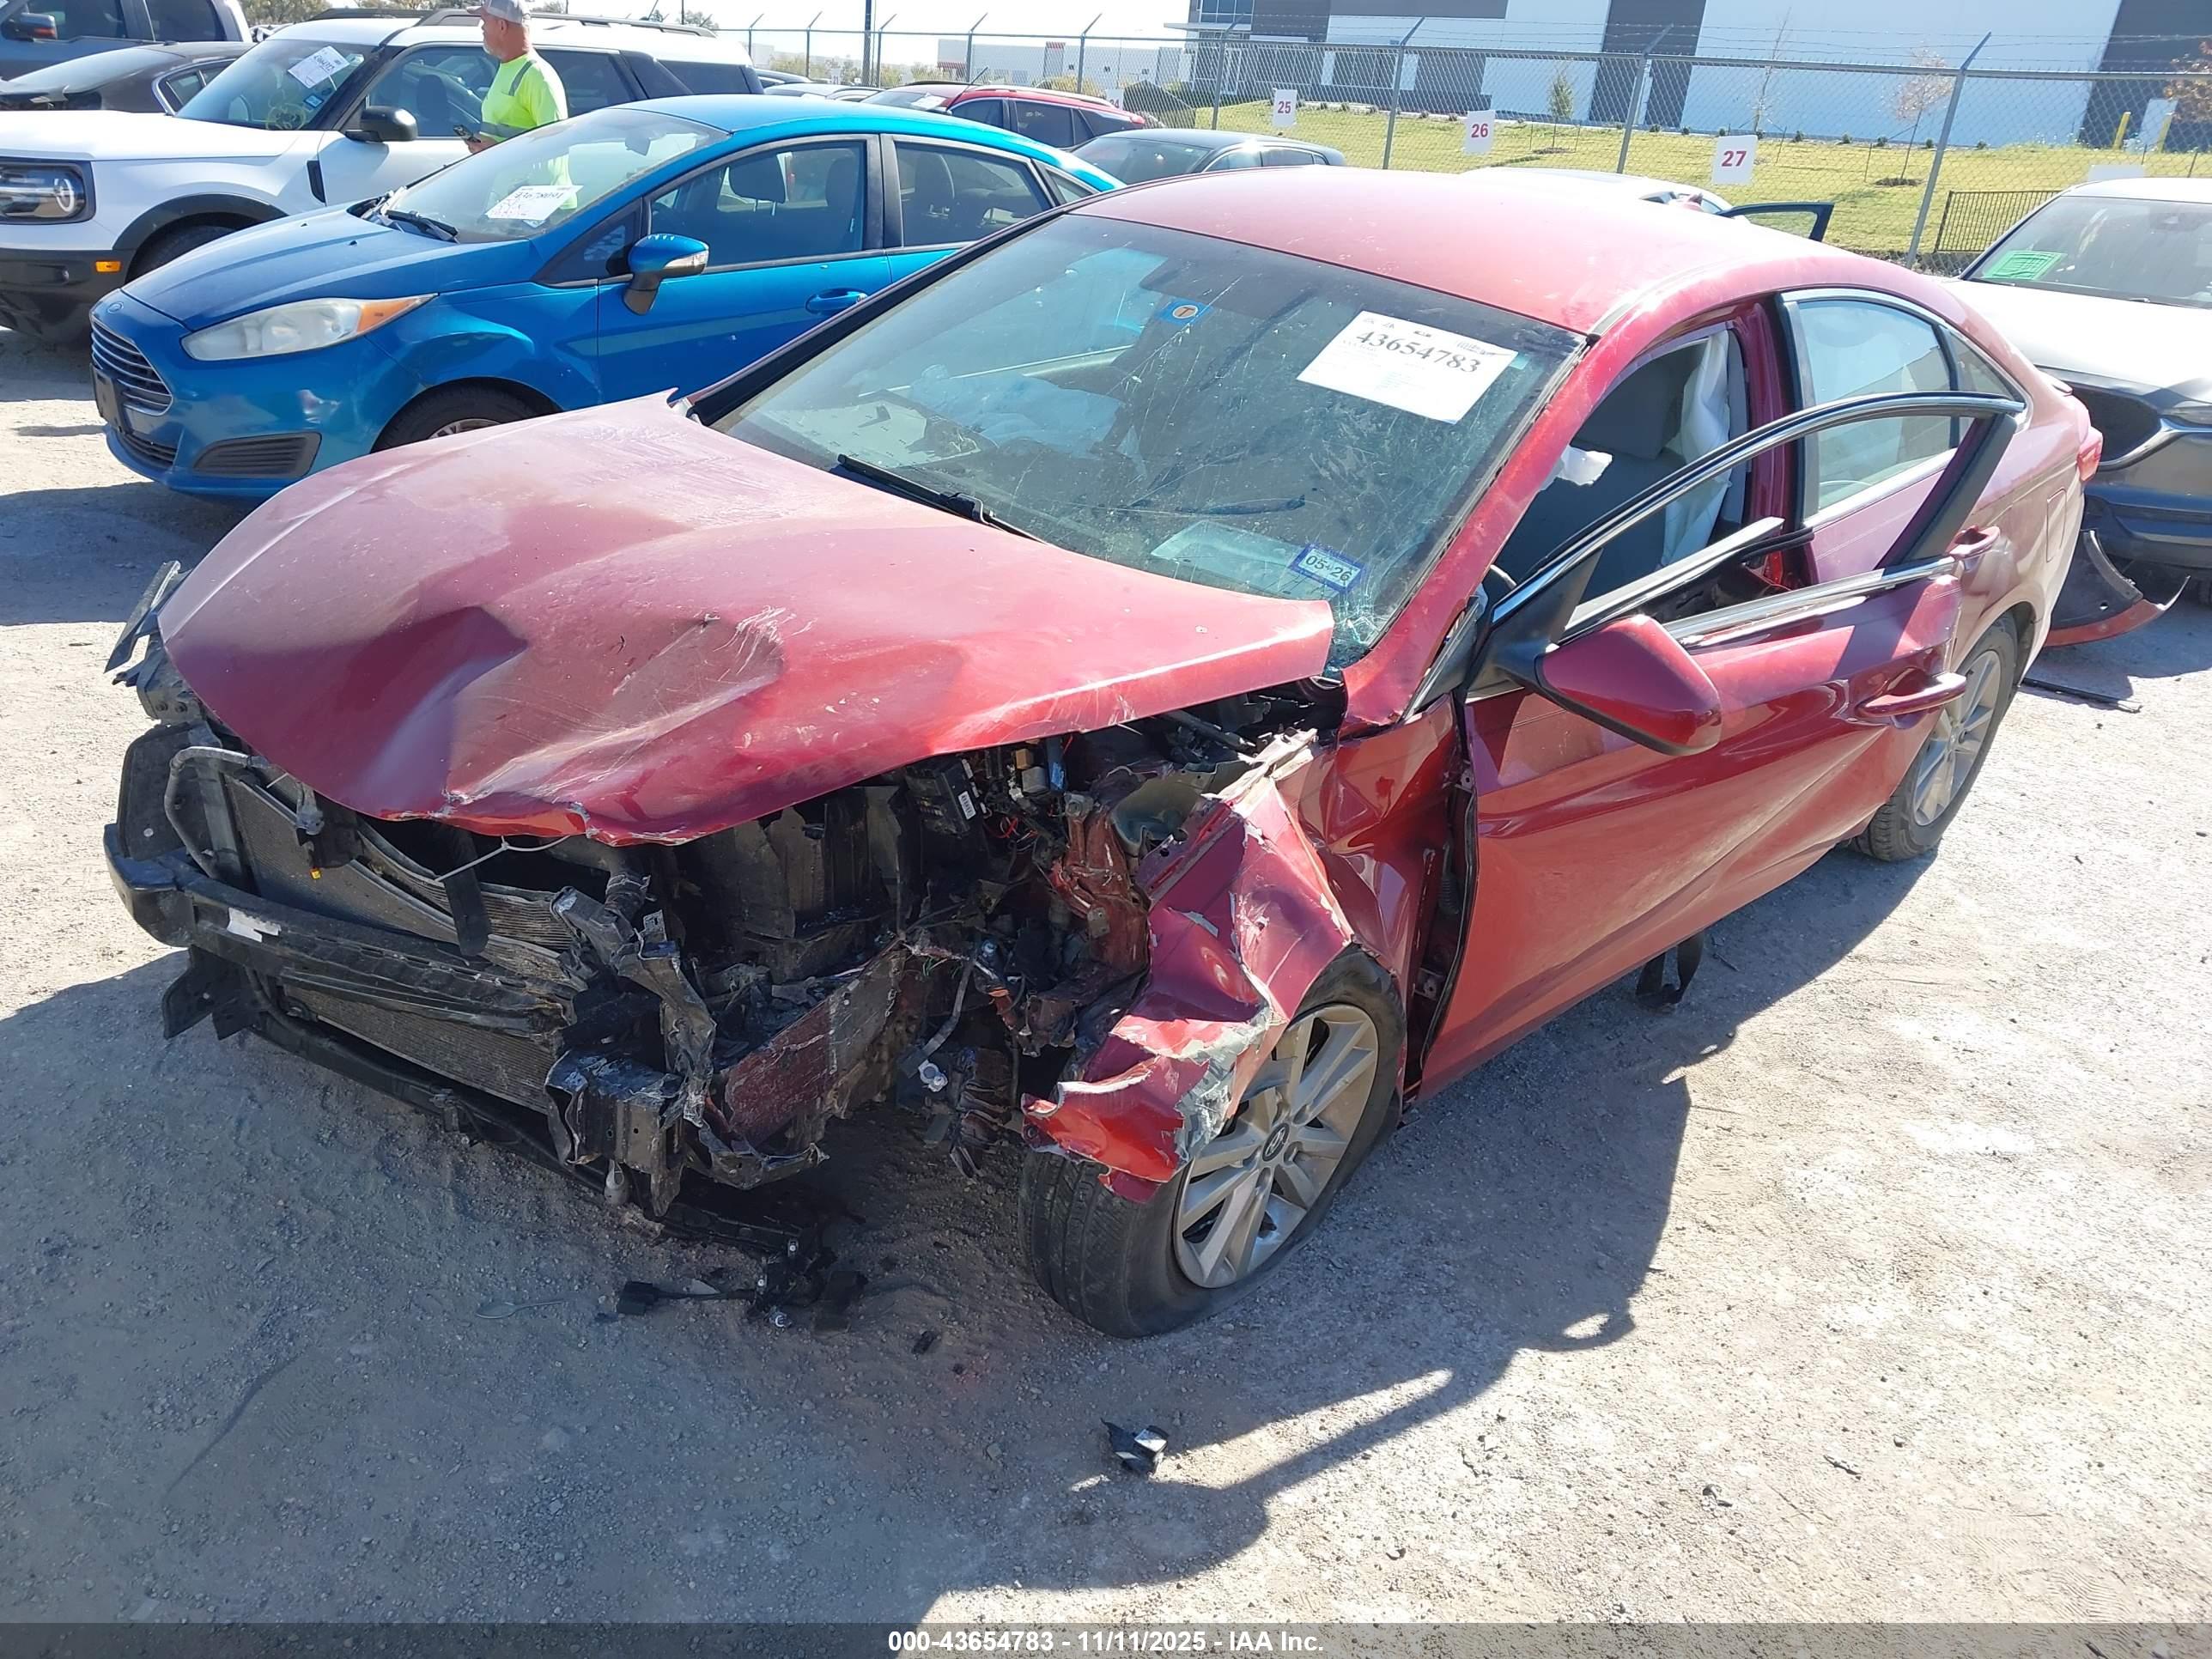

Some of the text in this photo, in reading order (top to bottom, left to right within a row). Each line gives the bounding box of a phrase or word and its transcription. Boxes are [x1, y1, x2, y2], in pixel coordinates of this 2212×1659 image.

[1277, 100, 1292, 115] 25
[1471, 123, 1489, 138] 26
[1721, 149, 1747, 167] 27
[1355, 331, 1482, 373] 43654783
